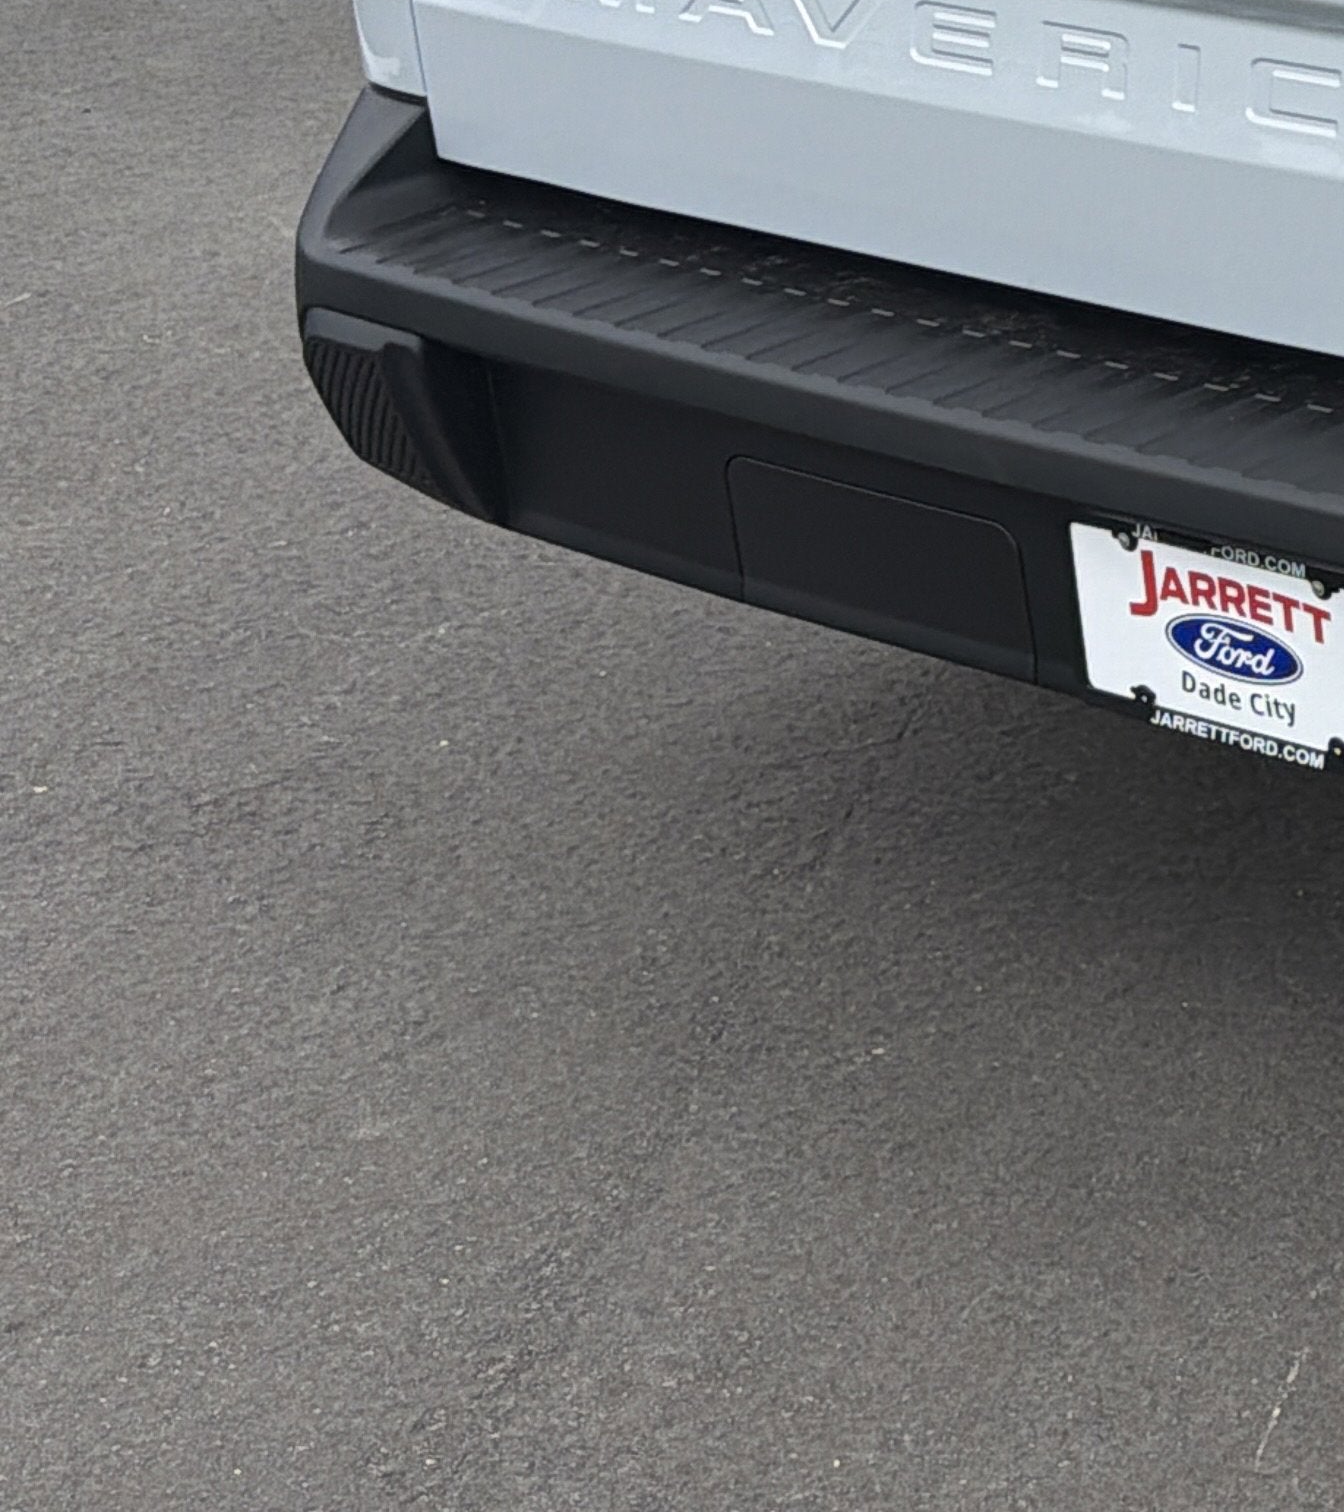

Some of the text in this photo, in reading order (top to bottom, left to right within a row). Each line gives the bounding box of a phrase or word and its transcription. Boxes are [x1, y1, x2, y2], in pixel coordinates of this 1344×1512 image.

[1129, 550, 1331, 644] JARRETT
[1194, 623, 1275, 676] Ford
[1182, 670, 1296, 727] Dade City
[1151, 710, 1325, 770] JARRETTFORD.COM
